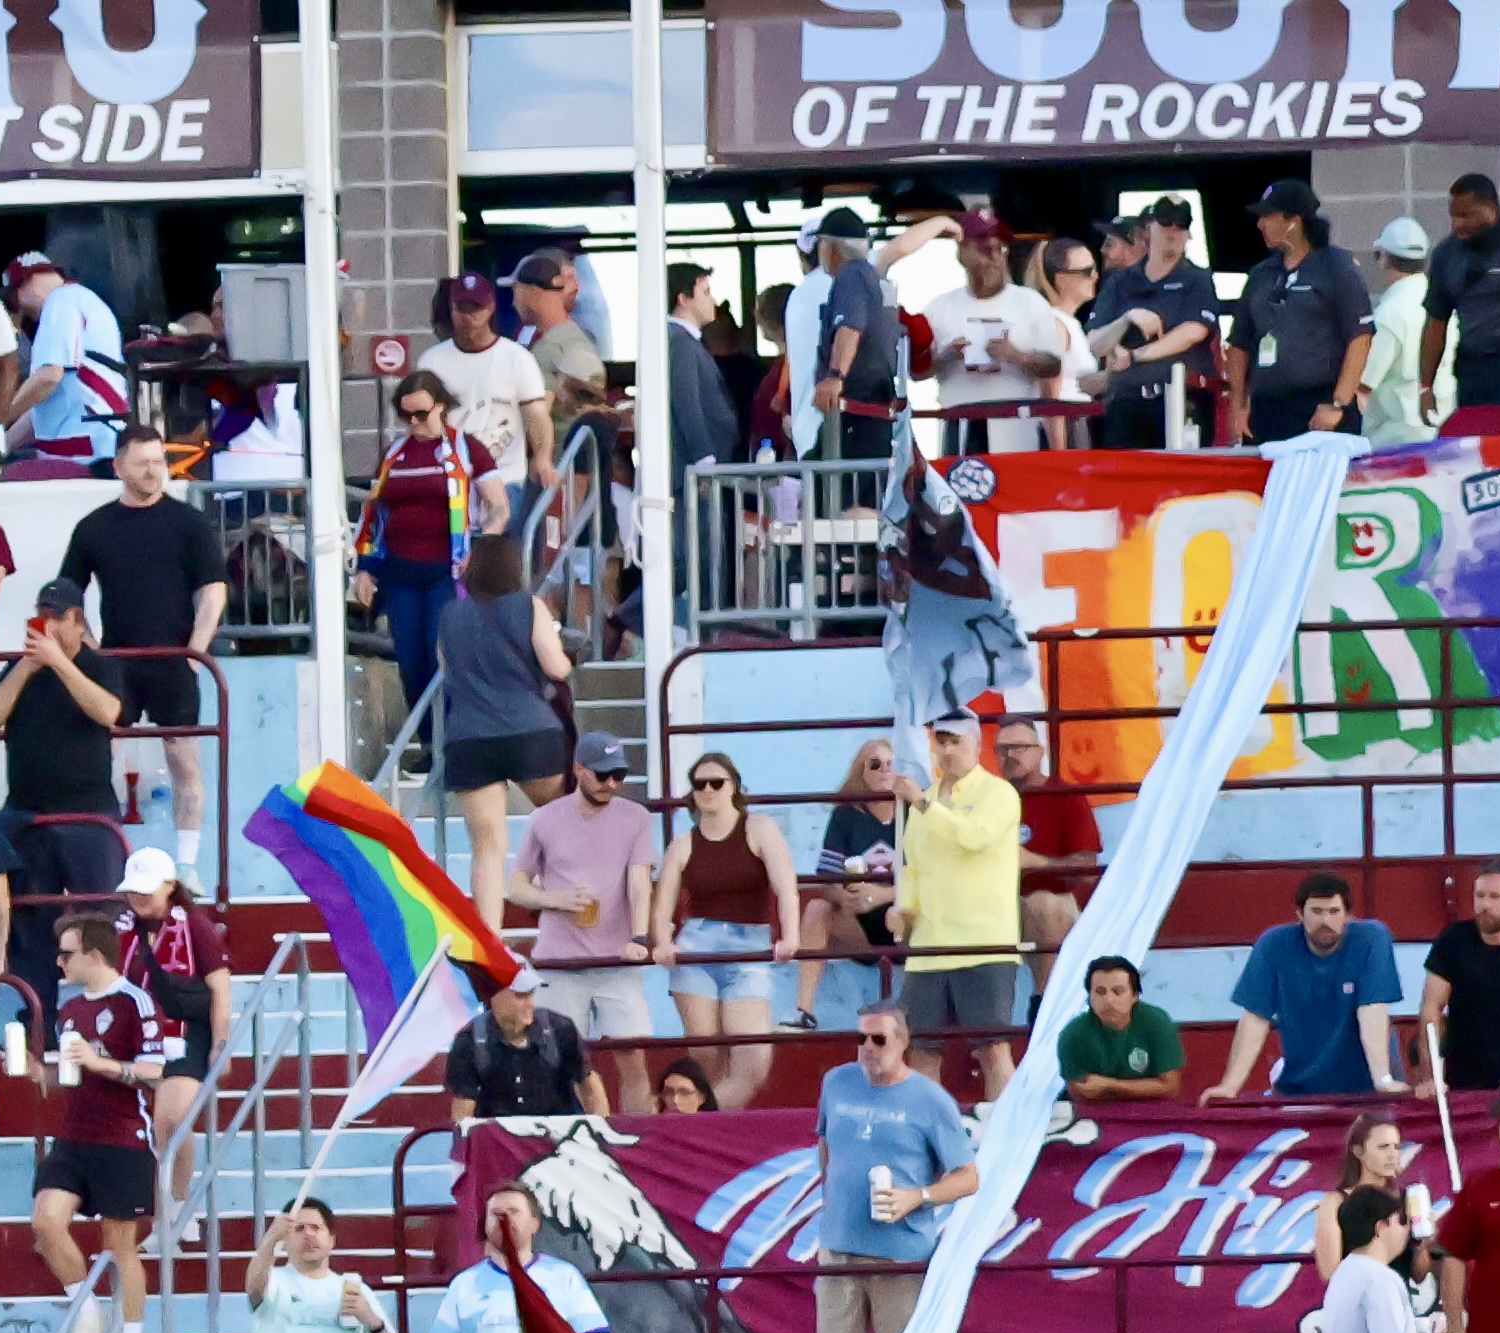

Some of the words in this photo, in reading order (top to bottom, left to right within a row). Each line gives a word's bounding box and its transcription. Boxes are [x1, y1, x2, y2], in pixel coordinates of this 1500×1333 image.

[31, 98, 211, 164] SIDE
[793, 84, 901, 149] OF
[917, 83, 1089, 143] THE
[1080, 78, 1426, 142] ROCKIES
